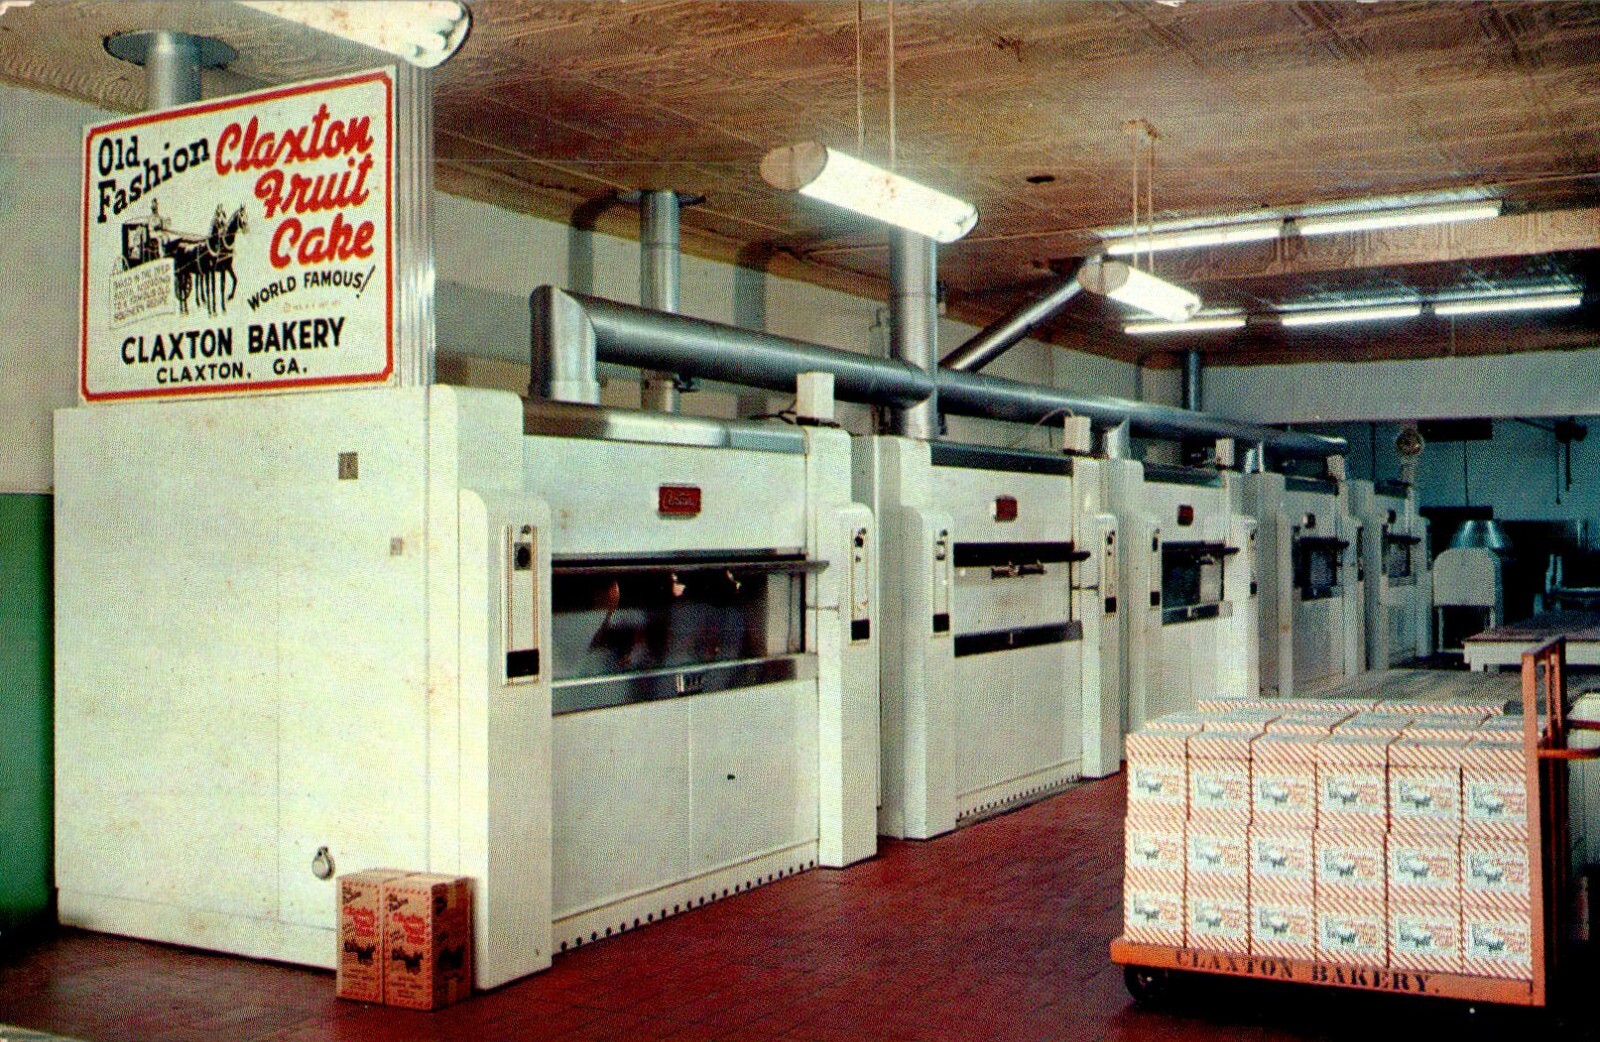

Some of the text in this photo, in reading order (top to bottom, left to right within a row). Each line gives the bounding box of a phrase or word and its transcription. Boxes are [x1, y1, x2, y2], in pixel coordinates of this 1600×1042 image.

[98, 134, 141, 177] Old
[215, 103, 375, 176] Claxton
[97, 137, 210, 223] Fashion
[254, 153, 374, 219] Fruit
[269, 212, 375, 270] Cake
[247, 275, 296, 312] WORLD
[303, 264, 376, 299] FAMOUS!
[121, 316, 345, 365] CLAXTON BAKERY
[272, 357, 308, 376] GA.
[1176, 948, 1440, 994] CLAXTON BAKERY.
